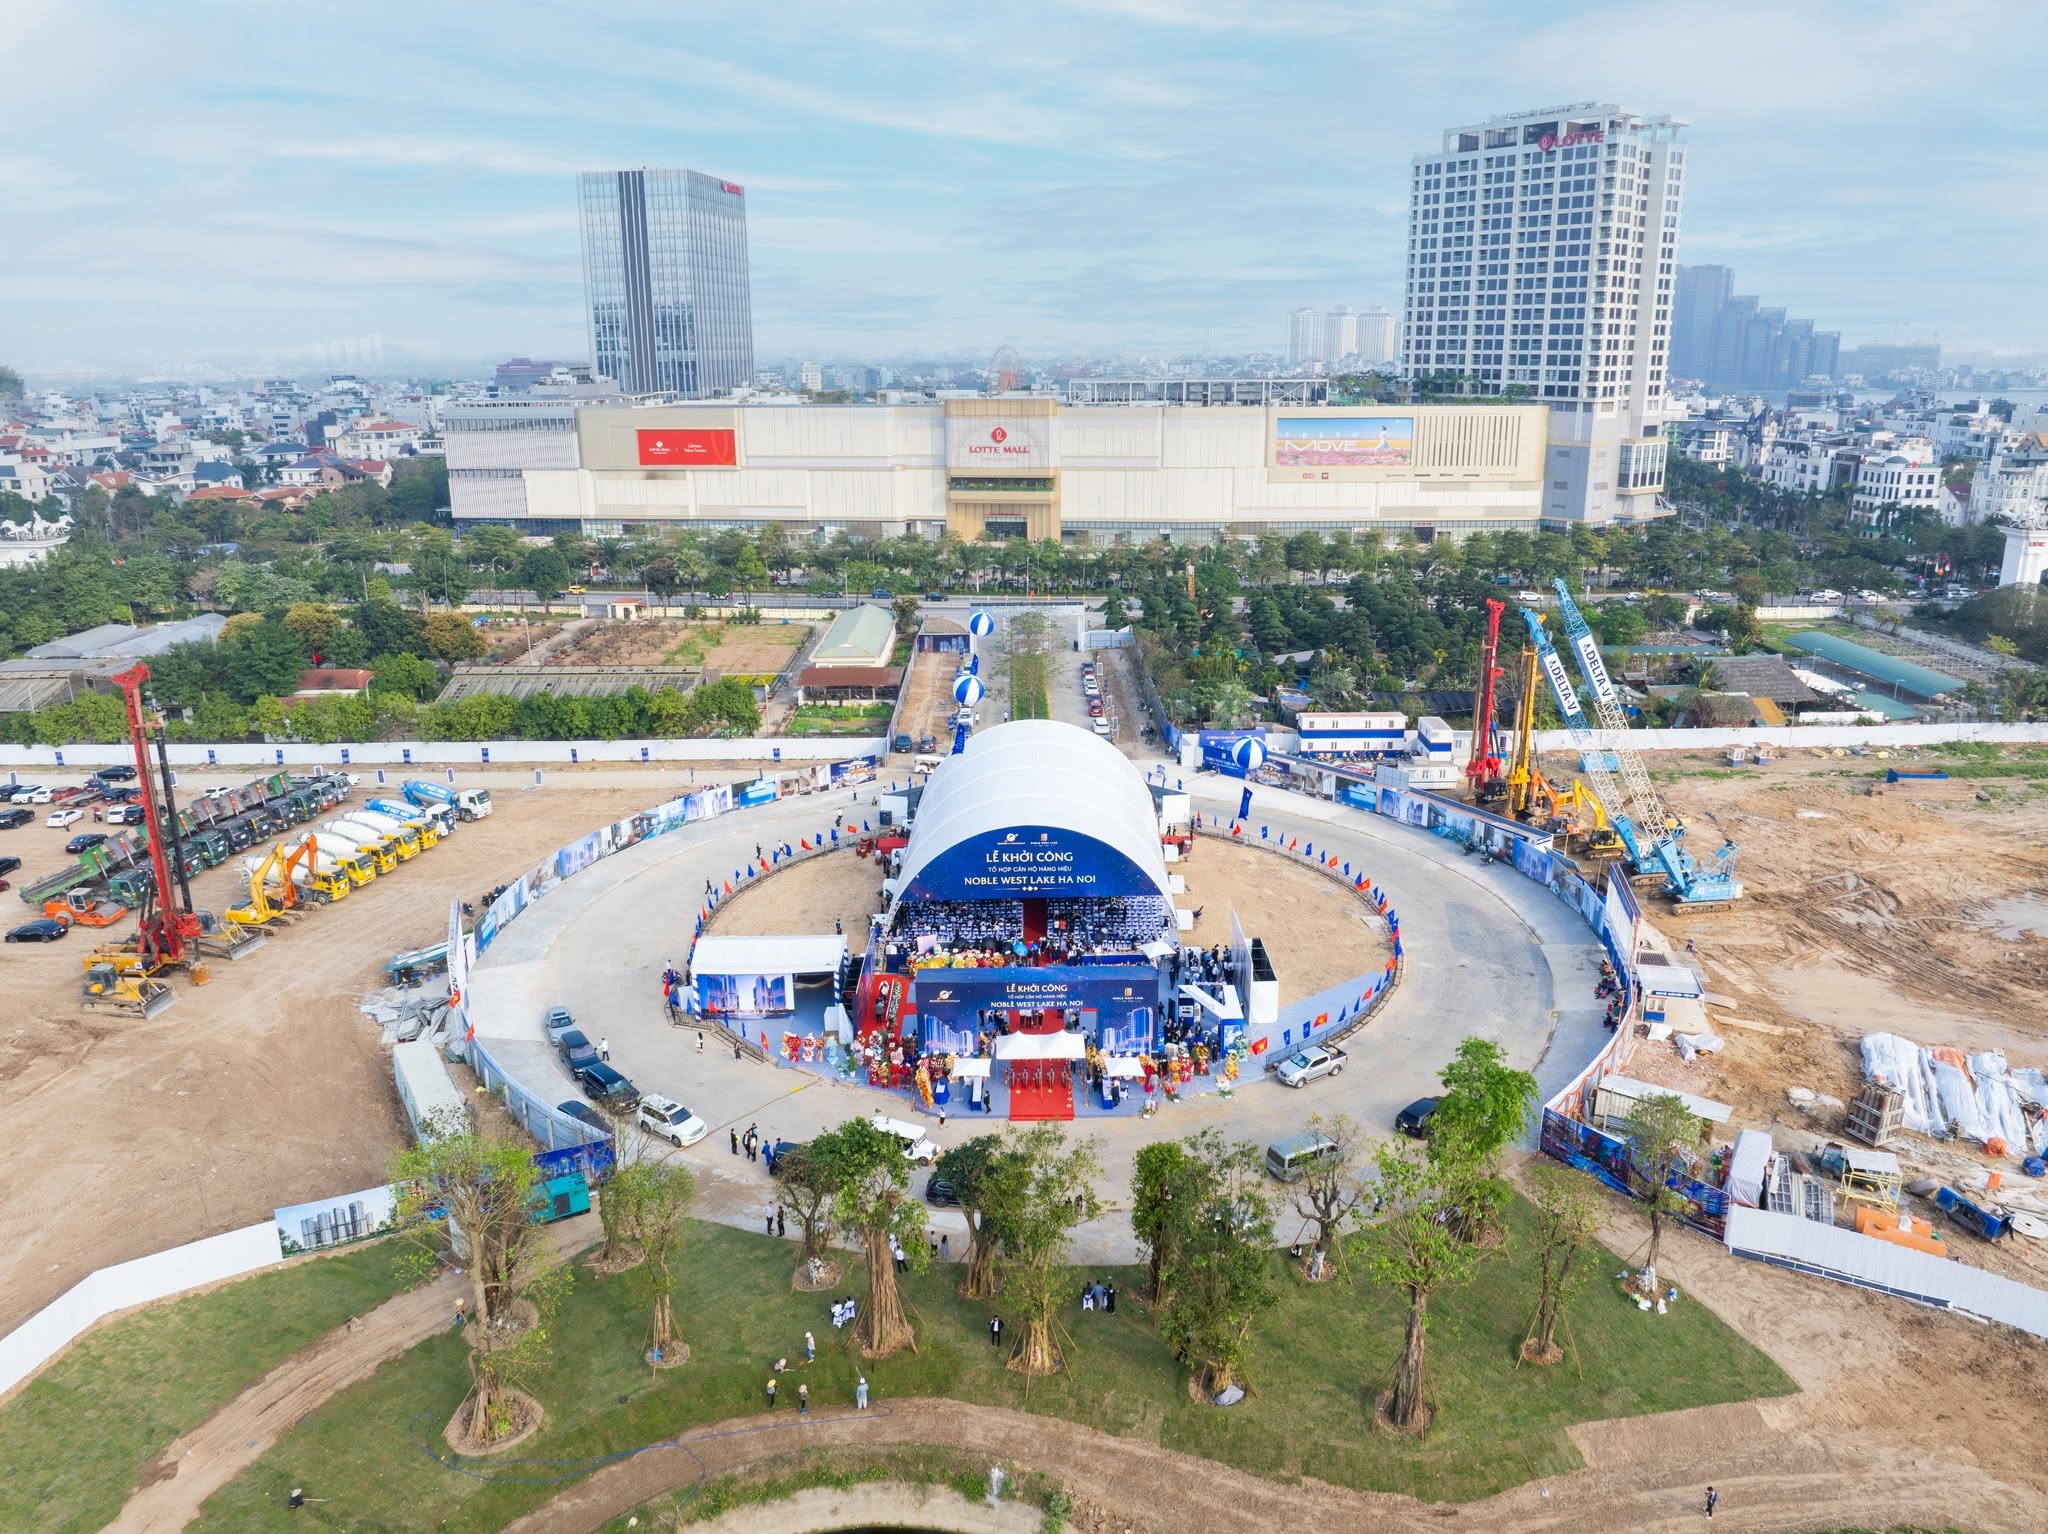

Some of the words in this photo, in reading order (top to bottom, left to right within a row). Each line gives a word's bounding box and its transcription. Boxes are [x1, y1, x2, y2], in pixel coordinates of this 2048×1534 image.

[1554, 130, 1605, 147] LOTTE
[969, 446, 1000, 454] LOTTE
[1003, 446, 1030, 454] MALL
[1284, 439, 1357, 452] MOVE
[1585, 650, 1612, 697] DELTA-V
[1551, 666, 1578, 710] DELTA-V
[986, 850, 999, 863] LỄ
[1002, 850, 1033, 863] KHỞI
[1036, 850, 1073, 862] CÔNG
[964, 877, 998, 885] NOBLE
[1000, 876, 1028, 885] WEST
[1030, 875, 1056, 884] LAKE
[1058, 875, 1073, 883] HA
[1076, 875, 1096, 883] NOI
[1006, 983, 1016, 992] LỄ
[1017, 983, 1040, 992] KHỞI
[1041, 983, 1068, 992] CÔNG
